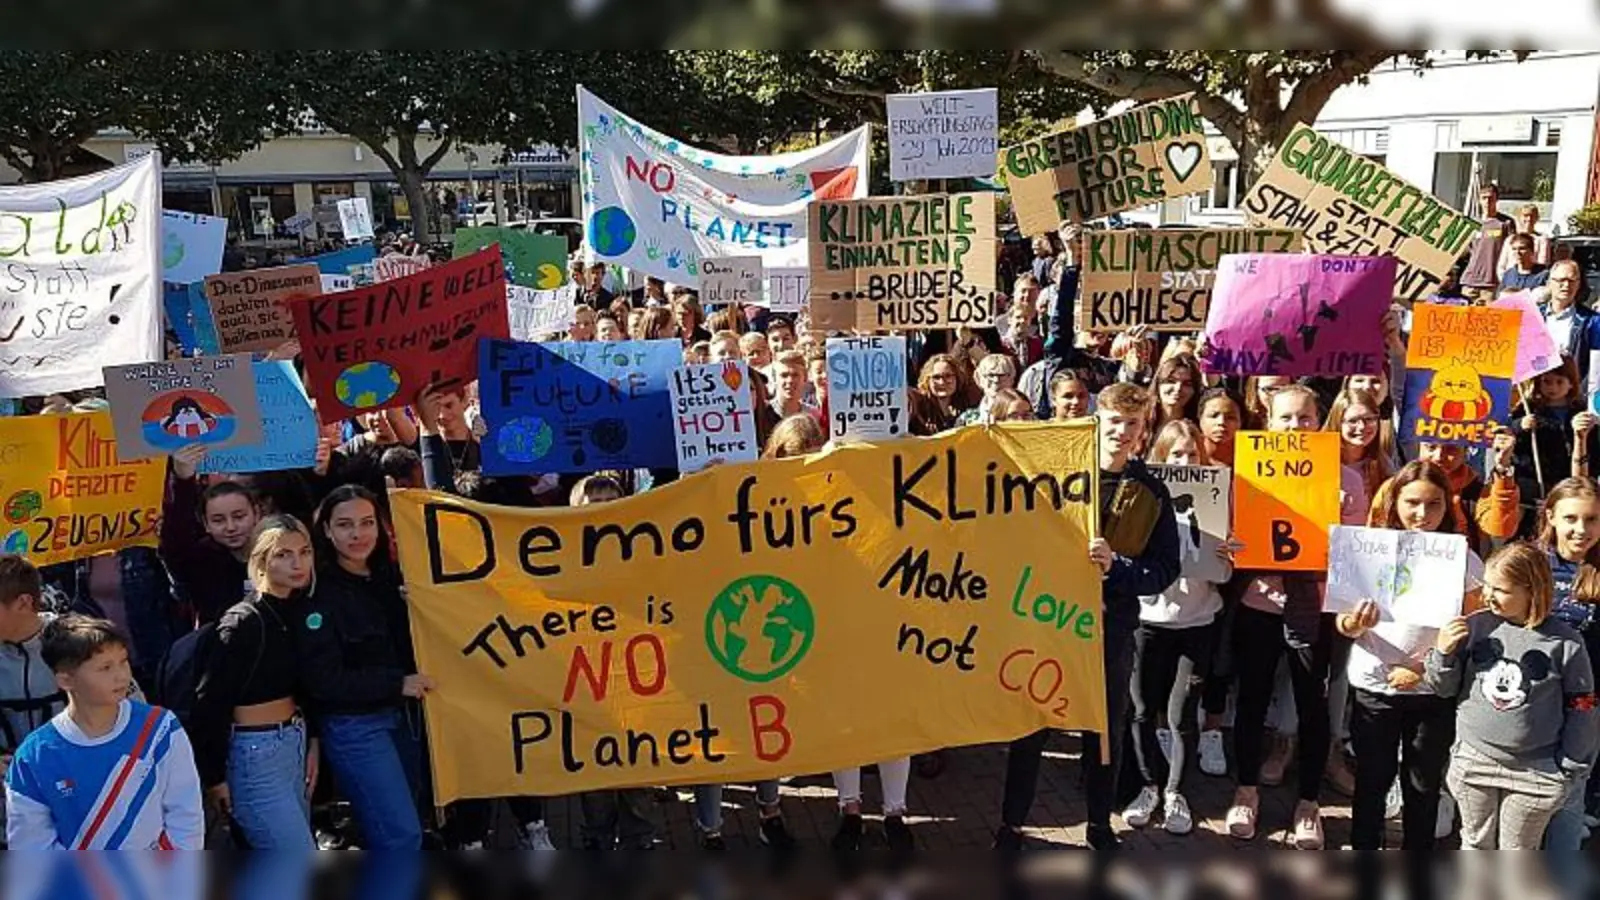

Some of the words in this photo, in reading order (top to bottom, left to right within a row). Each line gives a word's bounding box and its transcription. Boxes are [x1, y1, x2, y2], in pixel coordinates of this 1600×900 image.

[1006, 128, 1093, 179] GREEN
[1095, 98, 1206, 153] BUILDING
[625, 155, 676, 194] NO
[1077, 148, 1144, 189] FOR
[1053, 166, 1166, 220] FUTURE
[661, 199, 793, 249] PLANET
[819, 195, 976, 244] KLIMAZIELE
[1326, 198, 1411, 249] STATT
[825, 235, 971, 271] EINHALTEN?
[1233, 259, 1259, 275] WE
[209, 279, 242, 297] Die
[1160, 268, 1218, 288] STAT
[309, 280, 433, 335] KEINE
[877, 300, 939, 326] MUSS
[948, 291, 994, 325] LOS!
[313, 299, 499, 363] VERSCHMUTZUNG
[843, 337, 884, 350] THE
[1211, 348, 1281, 374] HAVE
[1418, 335, 1446, 358] IS
[1461, 338, 1511, 367] MY
[674, 367, 717, 396] It's
[827, 351, 904, 391] SNOW
[678, 393, 737, 414] getting
[849, 392, 895, 409] MUST
[679, 411, 750, 435] HOT
[834, 411, 856, 436] go
[681, 443, 698, 460] in
[705, 435, 747, 454] here
[1248, 434, 1310, 452] THERE
[49, 472, 138, 499] DEFIZITE
[1257, 460, 1278, 477] IS
[1284, 459, 1314, 477] NO
[1210, 487, 1221, 505] ?
[424, 503, 706, 585] Demo
[1271, 519, 1301, 562] B
[878, 545, 988, 602] Make
[1010, 565, 1095, 639] Love
[461, 595, 617, 669] There
[646, 595, 675, 627] is
[896, 622, 979, 671] not
[562, 632, 668, 704] NO
[510, 702, 727, 775] Planet
[748, 693, 793, 763] B
